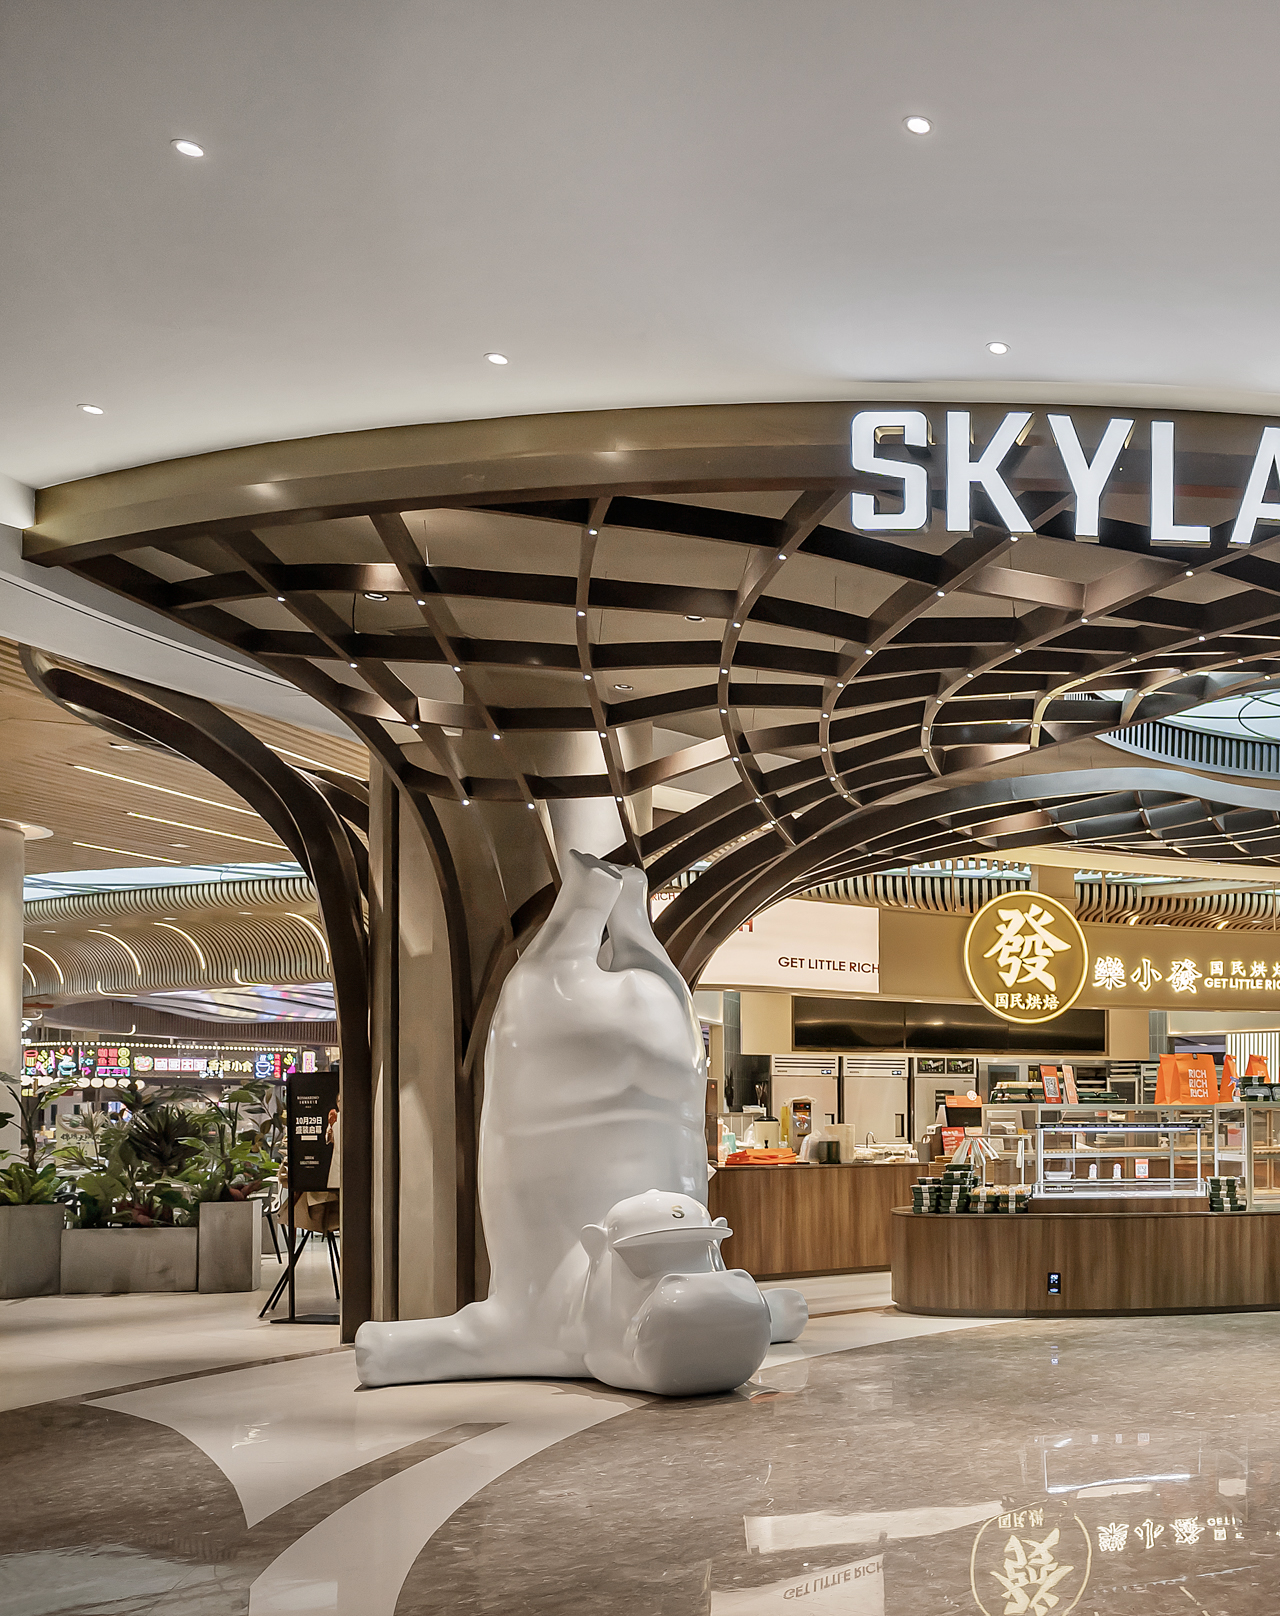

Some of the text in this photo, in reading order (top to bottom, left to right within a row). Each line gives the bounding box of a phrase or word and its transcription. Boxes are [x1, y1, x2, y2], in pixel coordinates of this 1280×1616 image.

[983, 903, 1072, 992] 發
[778, 956, 880, 974] GET LITTLE RICH
[1203, 977, 1229, 989] GET
[1229, 978, 1263, 990] LITTLE
[994, 992, 1060, 1010] 国民烘焙
[1188, 1069, 1207, 1079] RICH
[1189, 1079, 1208, 1088] RICH
[1190, 1088, 1209, 1098] RICH
[295, 1116, 323, 1125] 10月29日
[671, 1205, 685, 1219] S
